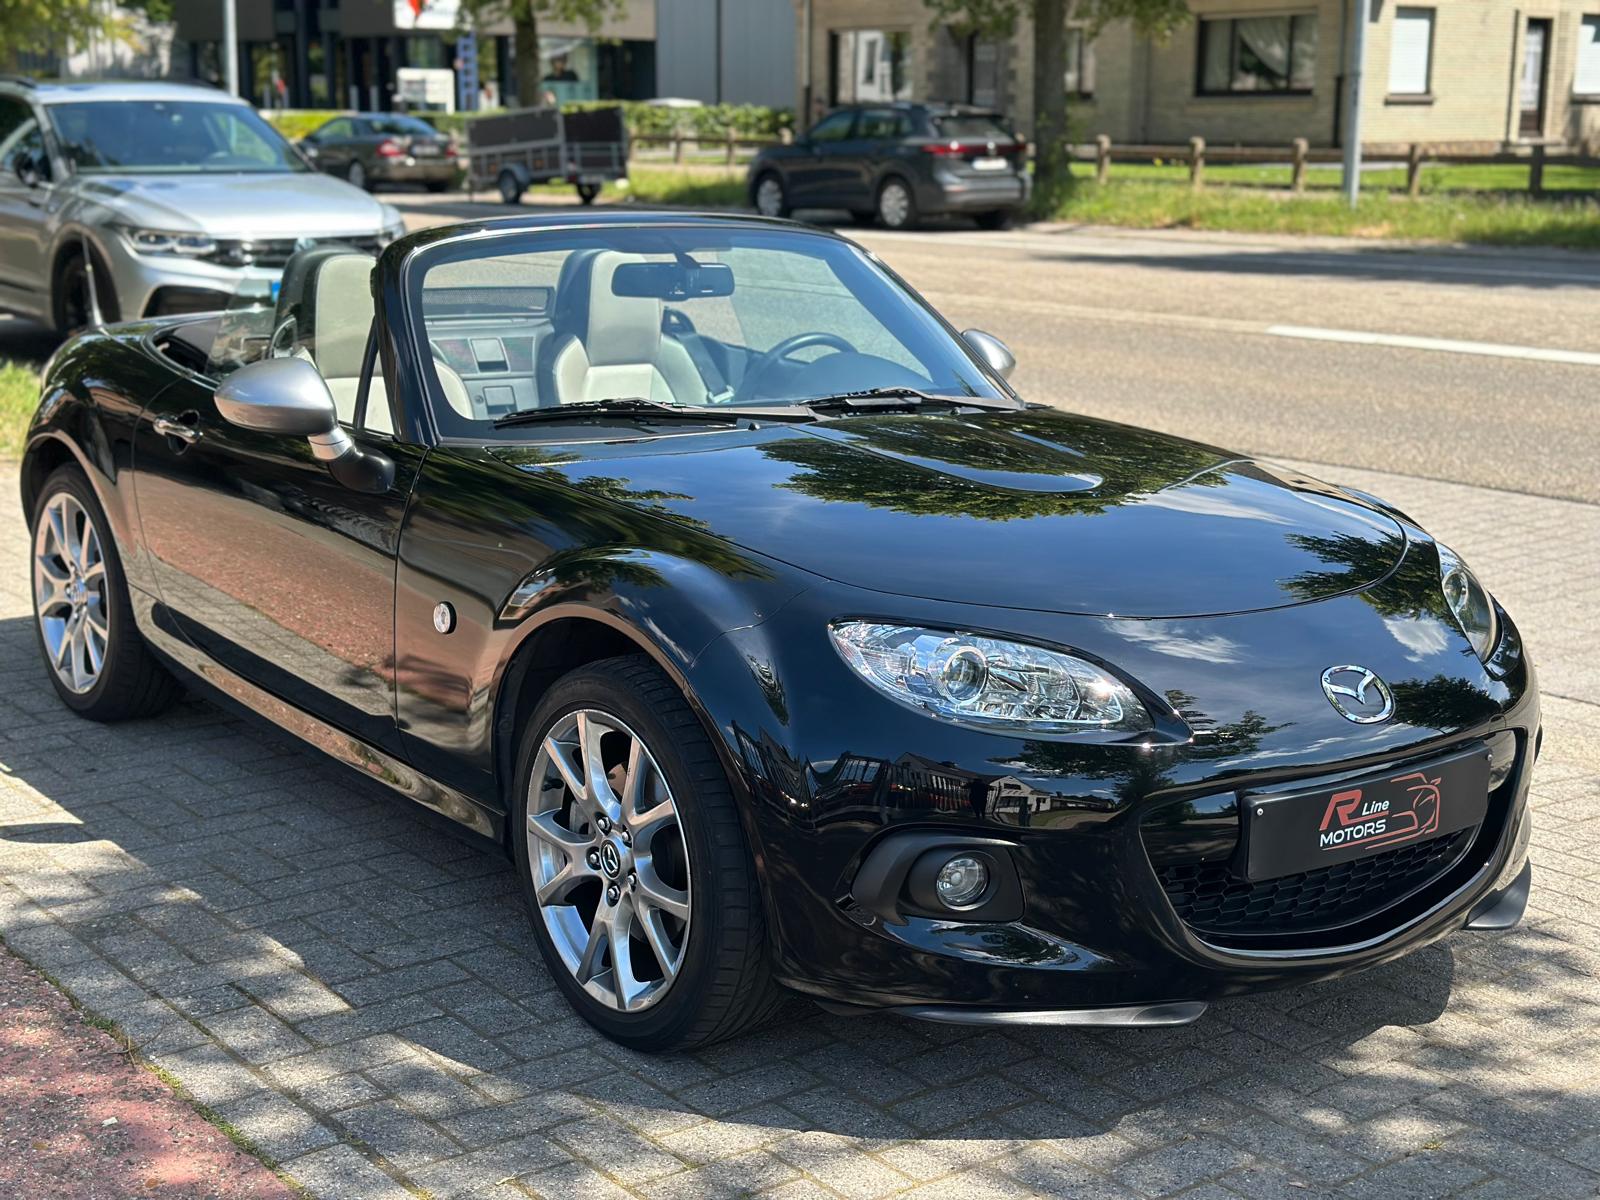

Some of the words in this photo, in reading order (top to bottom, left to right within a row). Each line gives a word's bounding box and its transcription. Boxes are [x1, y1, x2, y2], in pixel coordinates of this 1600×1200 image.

[1319, 789, 1362, 831] R
[1362, 800, 1389, 816] Line
[1320, 819, 1386, 847] MOTORS
